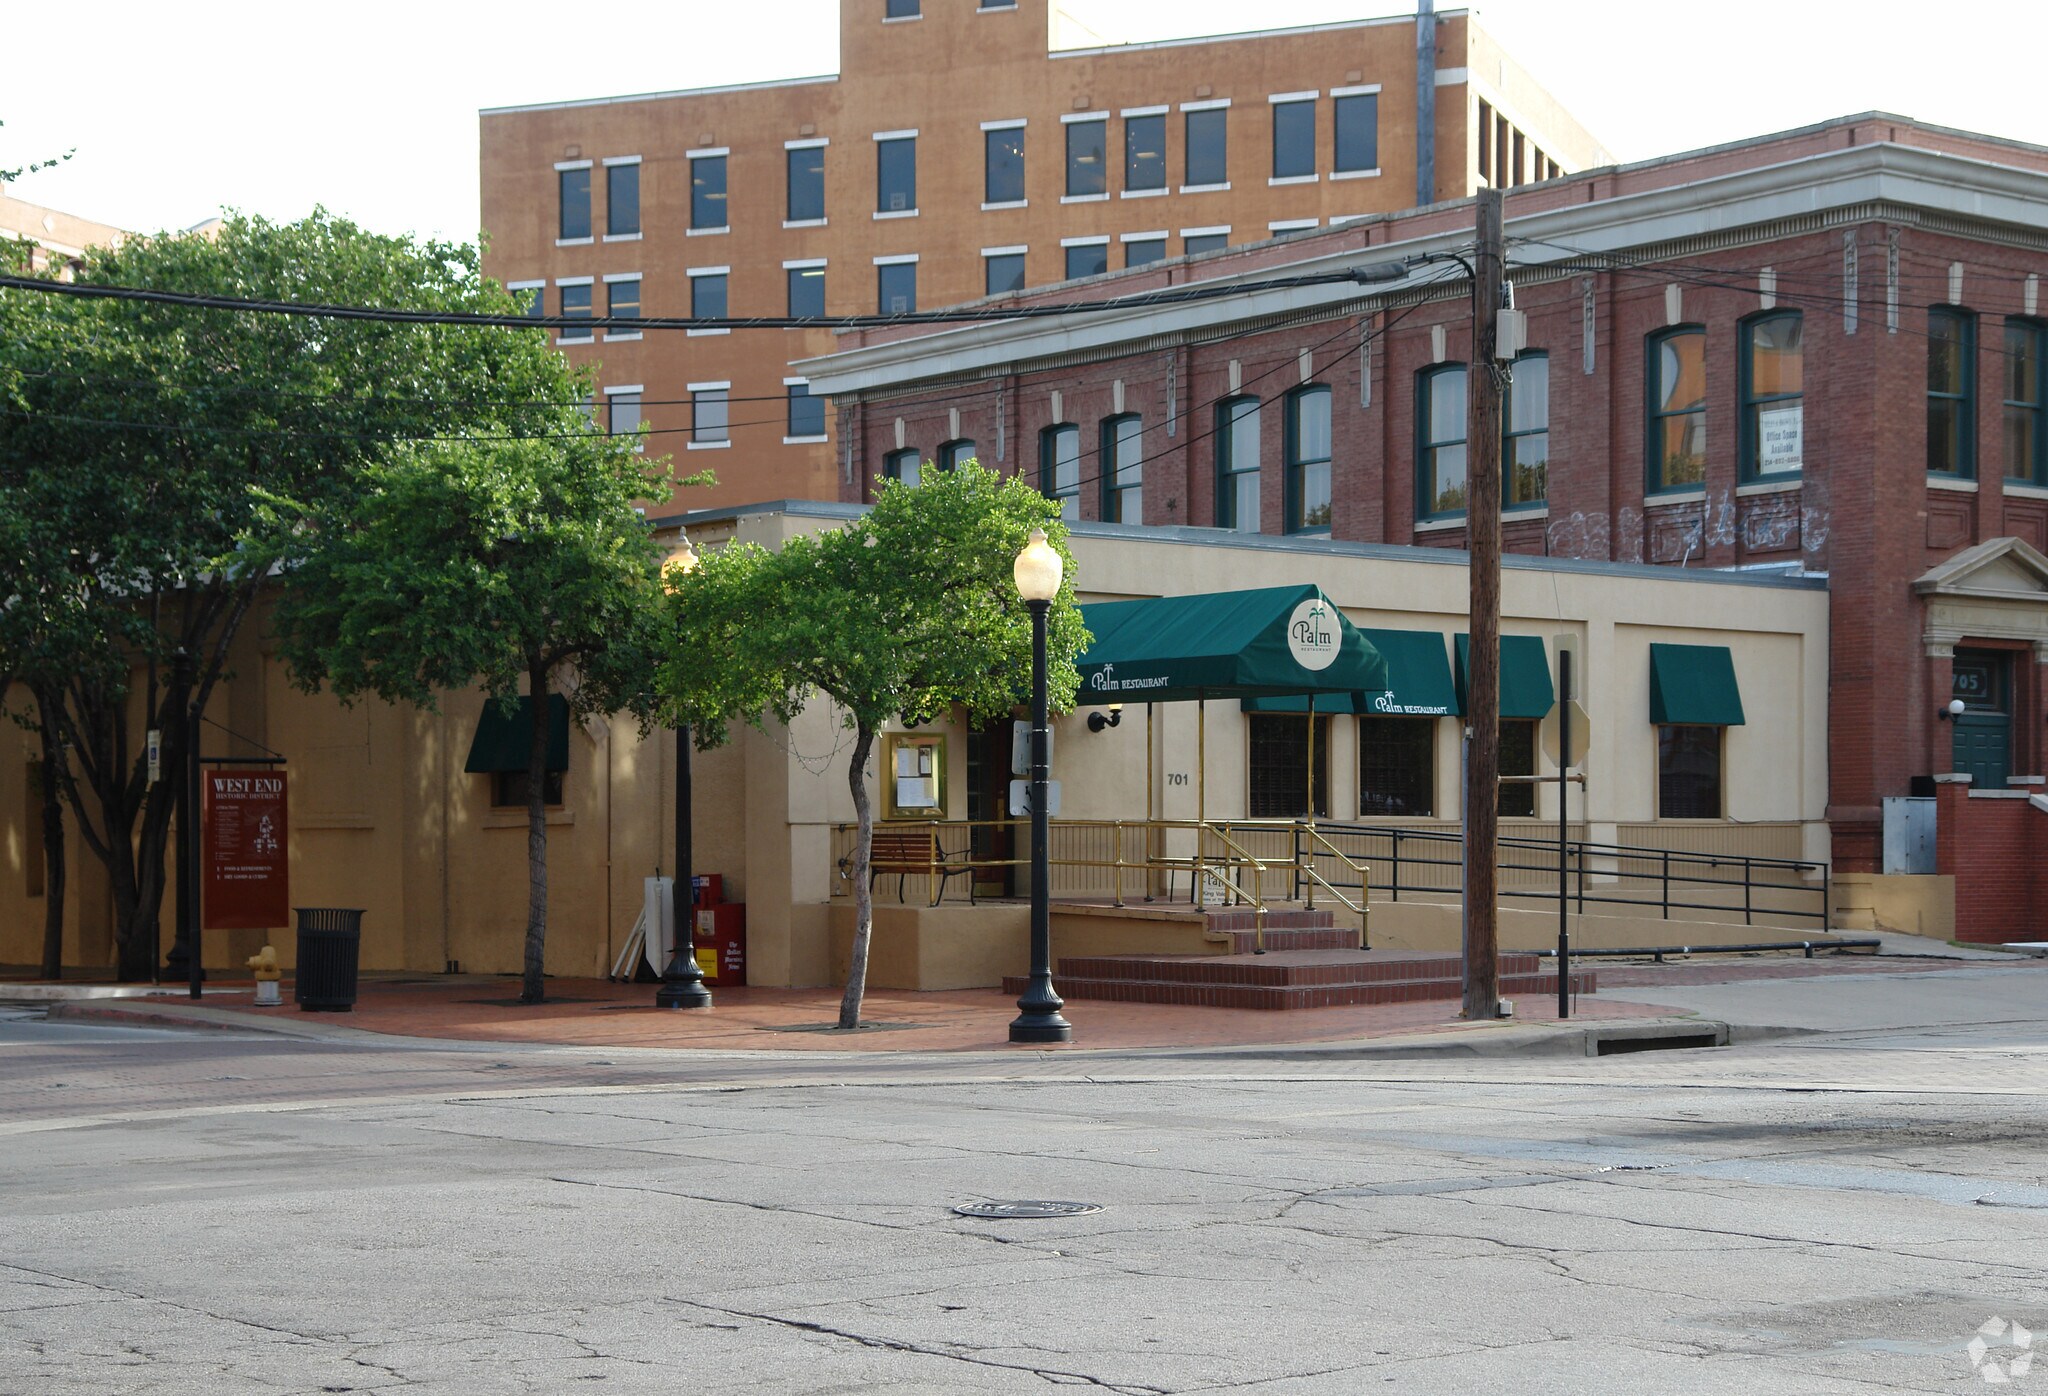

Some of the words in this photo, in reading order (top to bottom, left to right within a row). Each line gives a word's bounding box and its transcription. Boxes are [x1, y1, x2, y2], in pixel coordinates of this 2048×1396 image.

[1783, 430, 1798, 440] Space
[1771, 443, 1794, 454] Available
[1091, 663, 1120, 691] Palm
[1121, 676, 1169, 690] RESTAURANT
[1374, 690, 1404, 713] Palm
[1404, 705, 1448, 715] RESTAURANT
[214, 778, 251, 793] WEST
[255, 778, 282, 792] END
[1167, 773, 1188, 786] 701
